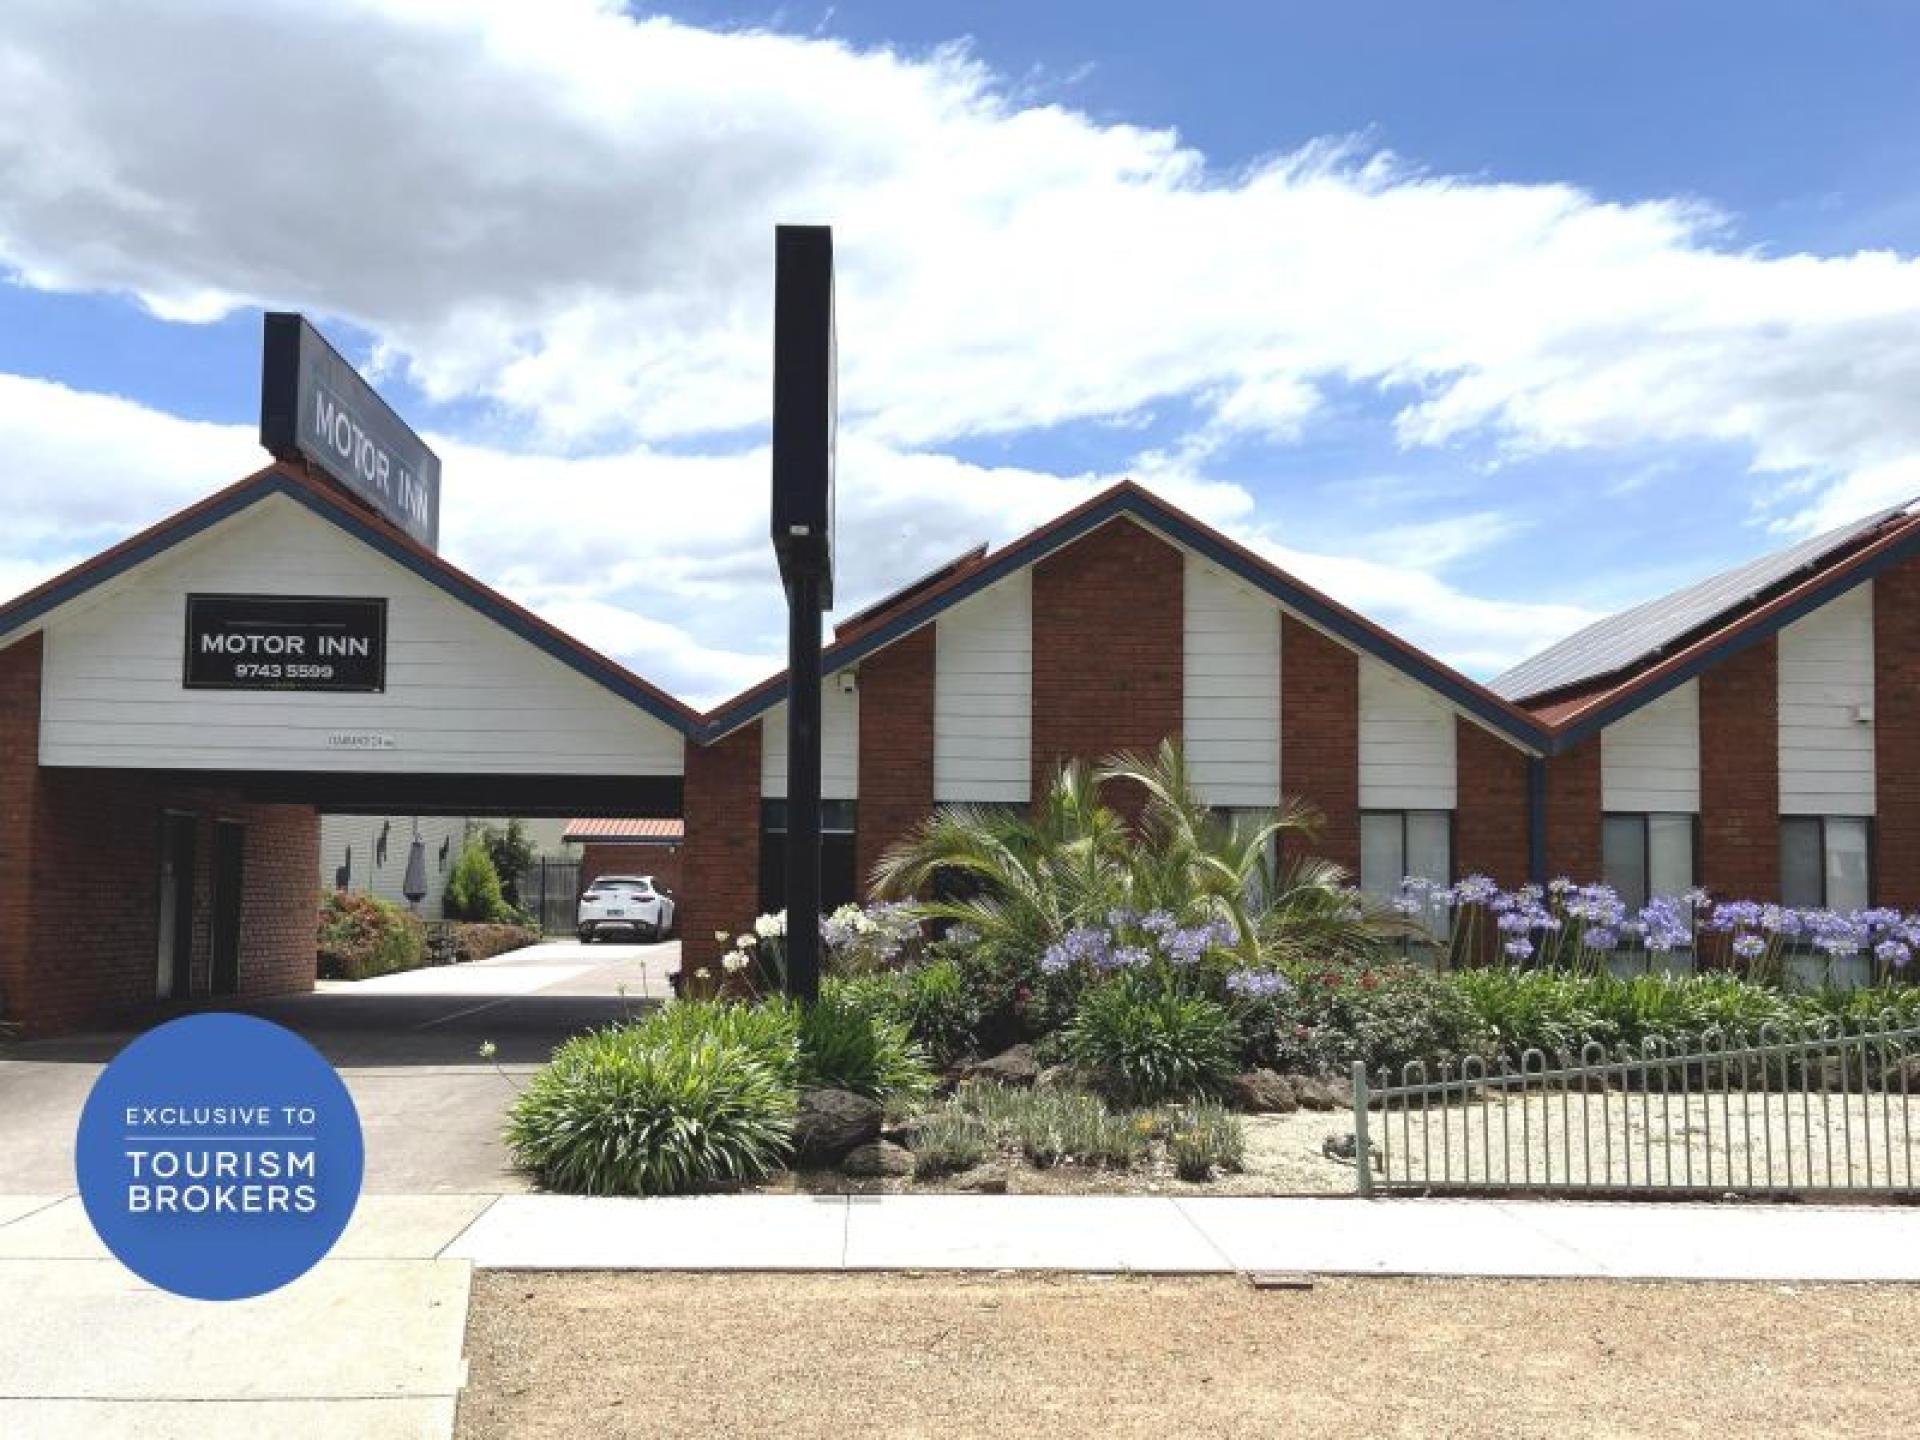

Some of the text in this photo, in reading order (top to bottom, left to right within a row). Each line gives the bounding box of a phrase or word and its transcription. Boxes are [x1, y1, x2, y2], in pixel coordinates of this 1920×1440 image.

[315, 391, 429, 528] MOTOR INN
[201, 633, 370, 656] MOTOR INN
[235, 664, 282, 678] 9743
